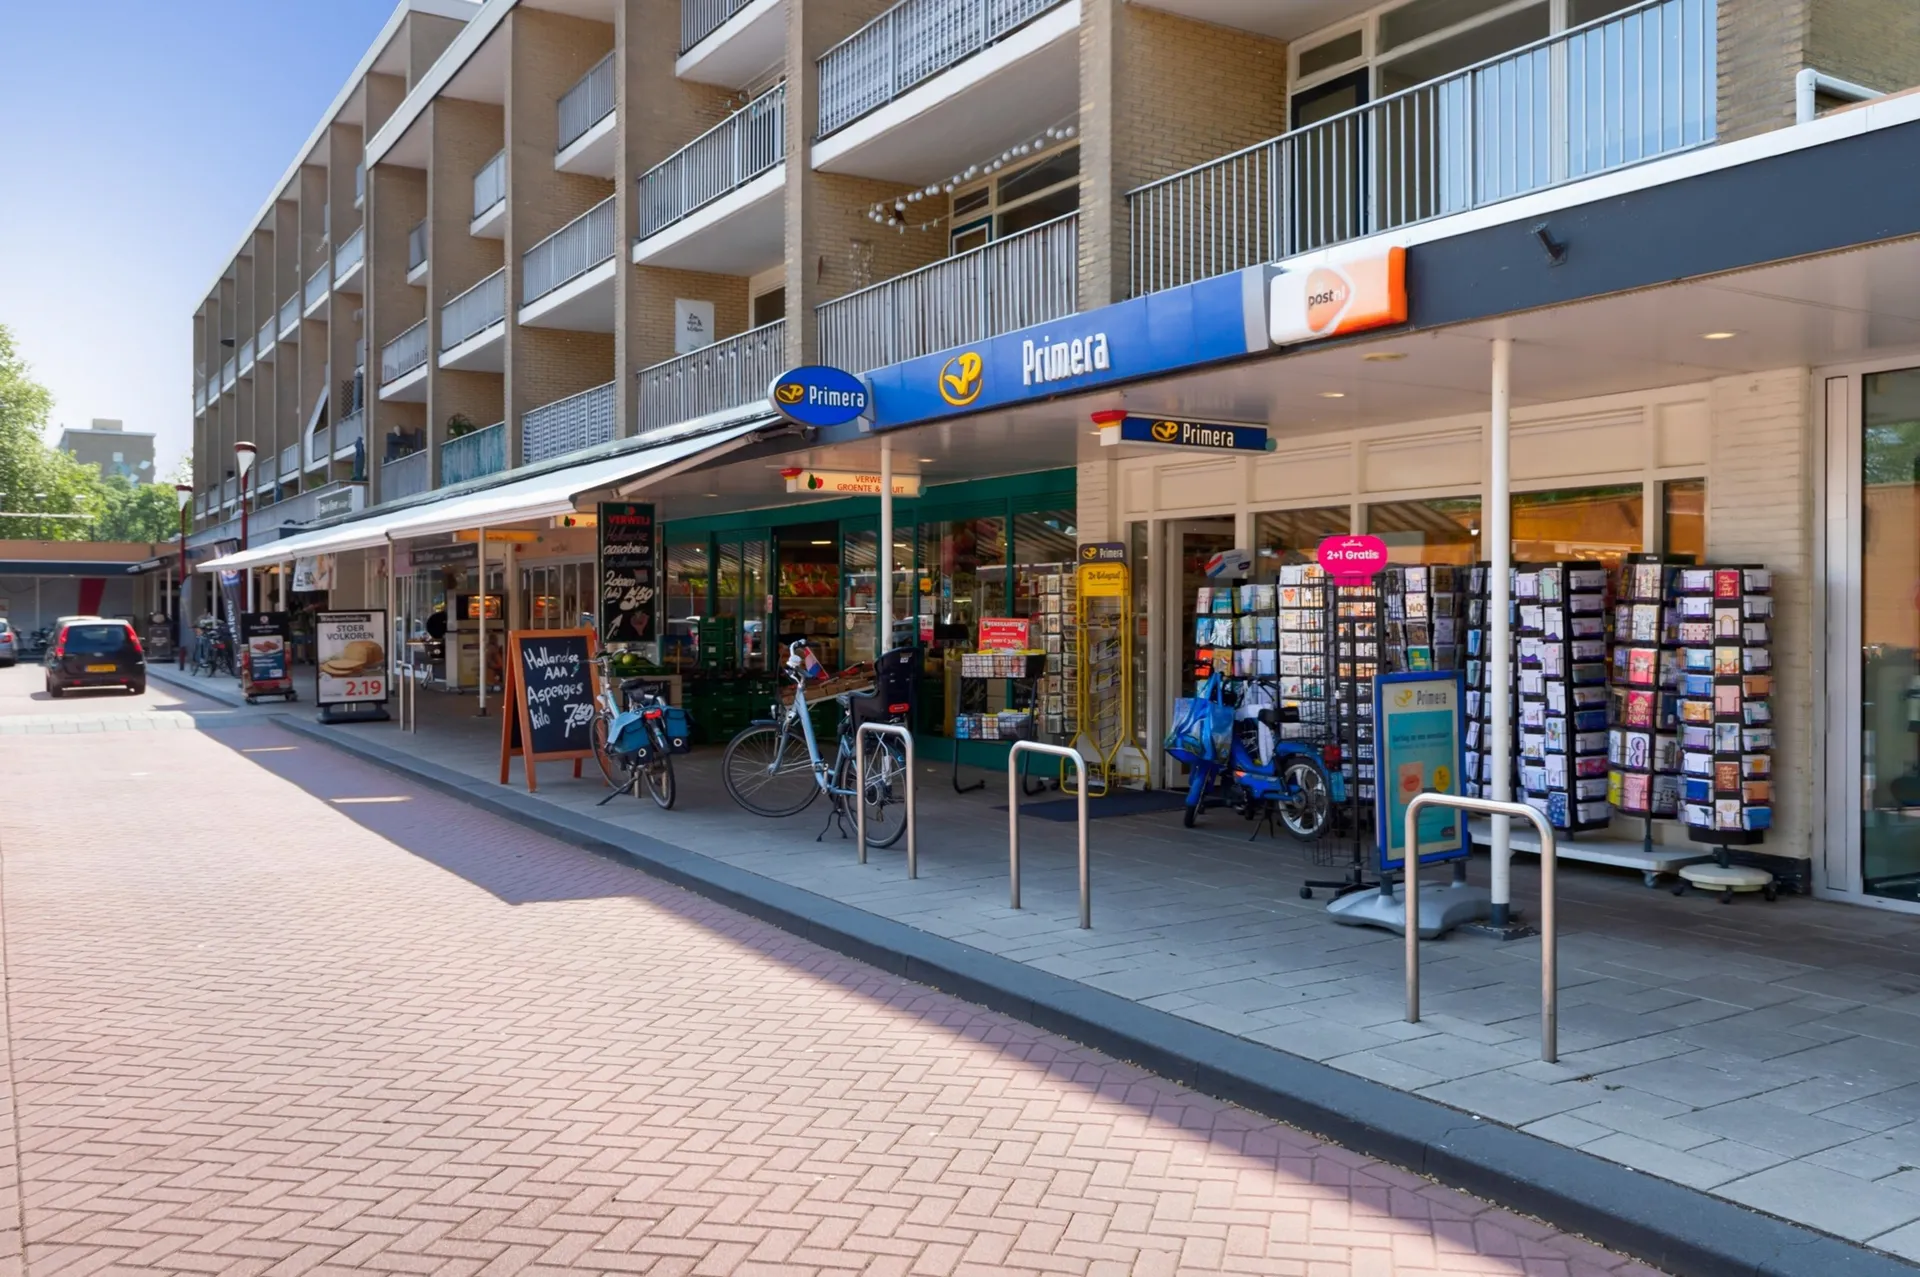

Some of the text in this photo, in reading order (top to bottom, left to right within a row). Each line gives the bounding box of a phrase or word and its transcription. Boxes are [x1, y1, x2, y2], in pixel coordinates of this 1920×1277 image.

[1022, 332, 1110, 386] Primera
[809, 386, 864, 408] Primera
[1182, 423, 1234, 447] Primera
[855, 475, 882, 483] VERWE
[837, 484, 872, 492] GROENTE
[1100, 548, 1123, 558] Primera
[1326, 550, 1379, 560] 2+1 Gratis
[326, 632, 374, 640] VOLKOREN
[523, 646, 579, 670] Hollandse
[345, 680, 382, 696] 2.19
[527, 682, 584, 706] Asperges
[1416, 689, 1447, 705] Primera
[530, 706, 551, 730] kilo
